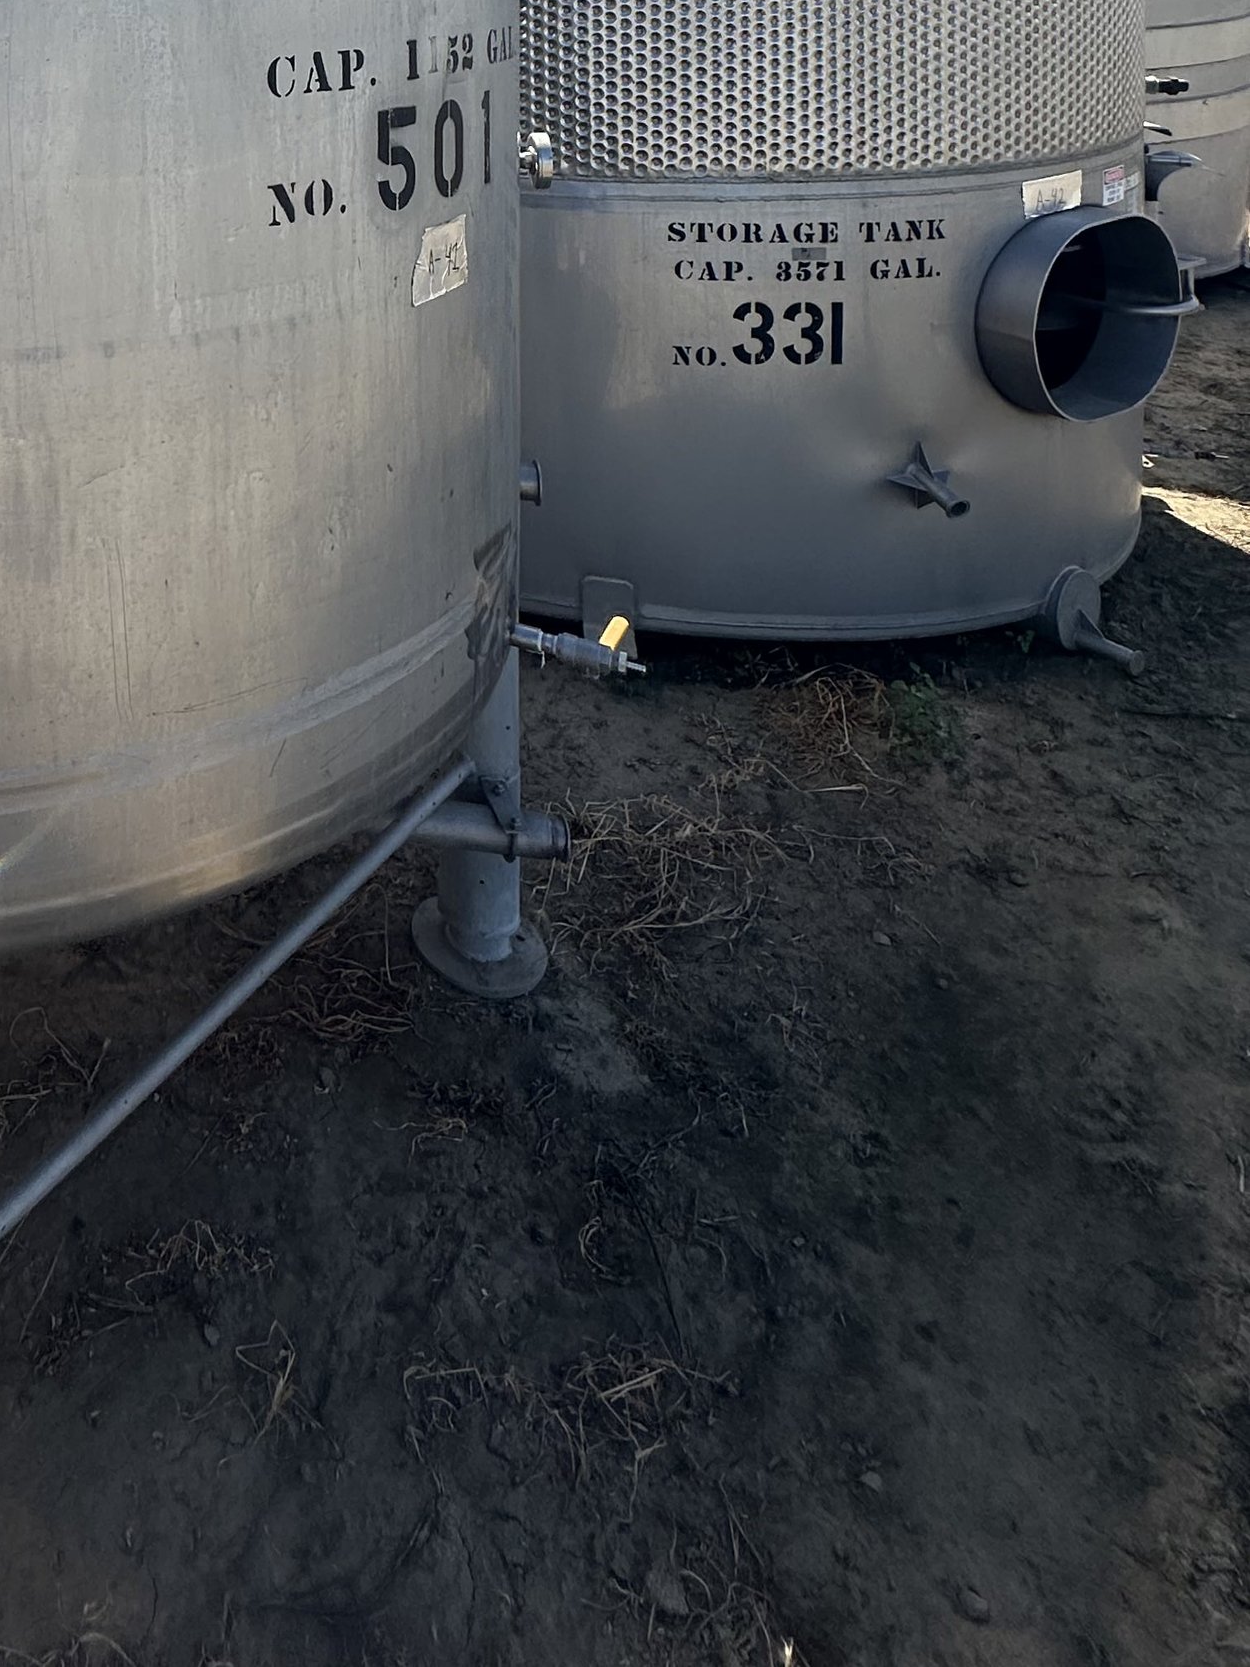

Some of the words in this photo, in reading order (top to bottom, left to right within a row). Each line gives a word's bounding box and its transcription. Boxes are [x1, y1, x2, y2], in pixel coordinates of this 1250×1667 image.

[266, 49, 377, 98] CAP.
[267, 179, 347, 226] NO.
[377, 90, 491, 211] 501
[667, 222, 839, 244] STORAGE
[859, 219, 945, 242] TANK
[674, 260, 754, 282] CAP.
[775, 260, 846, 282] 3571
[869, 257, 942, 280] GAL.
[672, 345, 727, 367] NO.
[732, 301, 844, 365] 331
